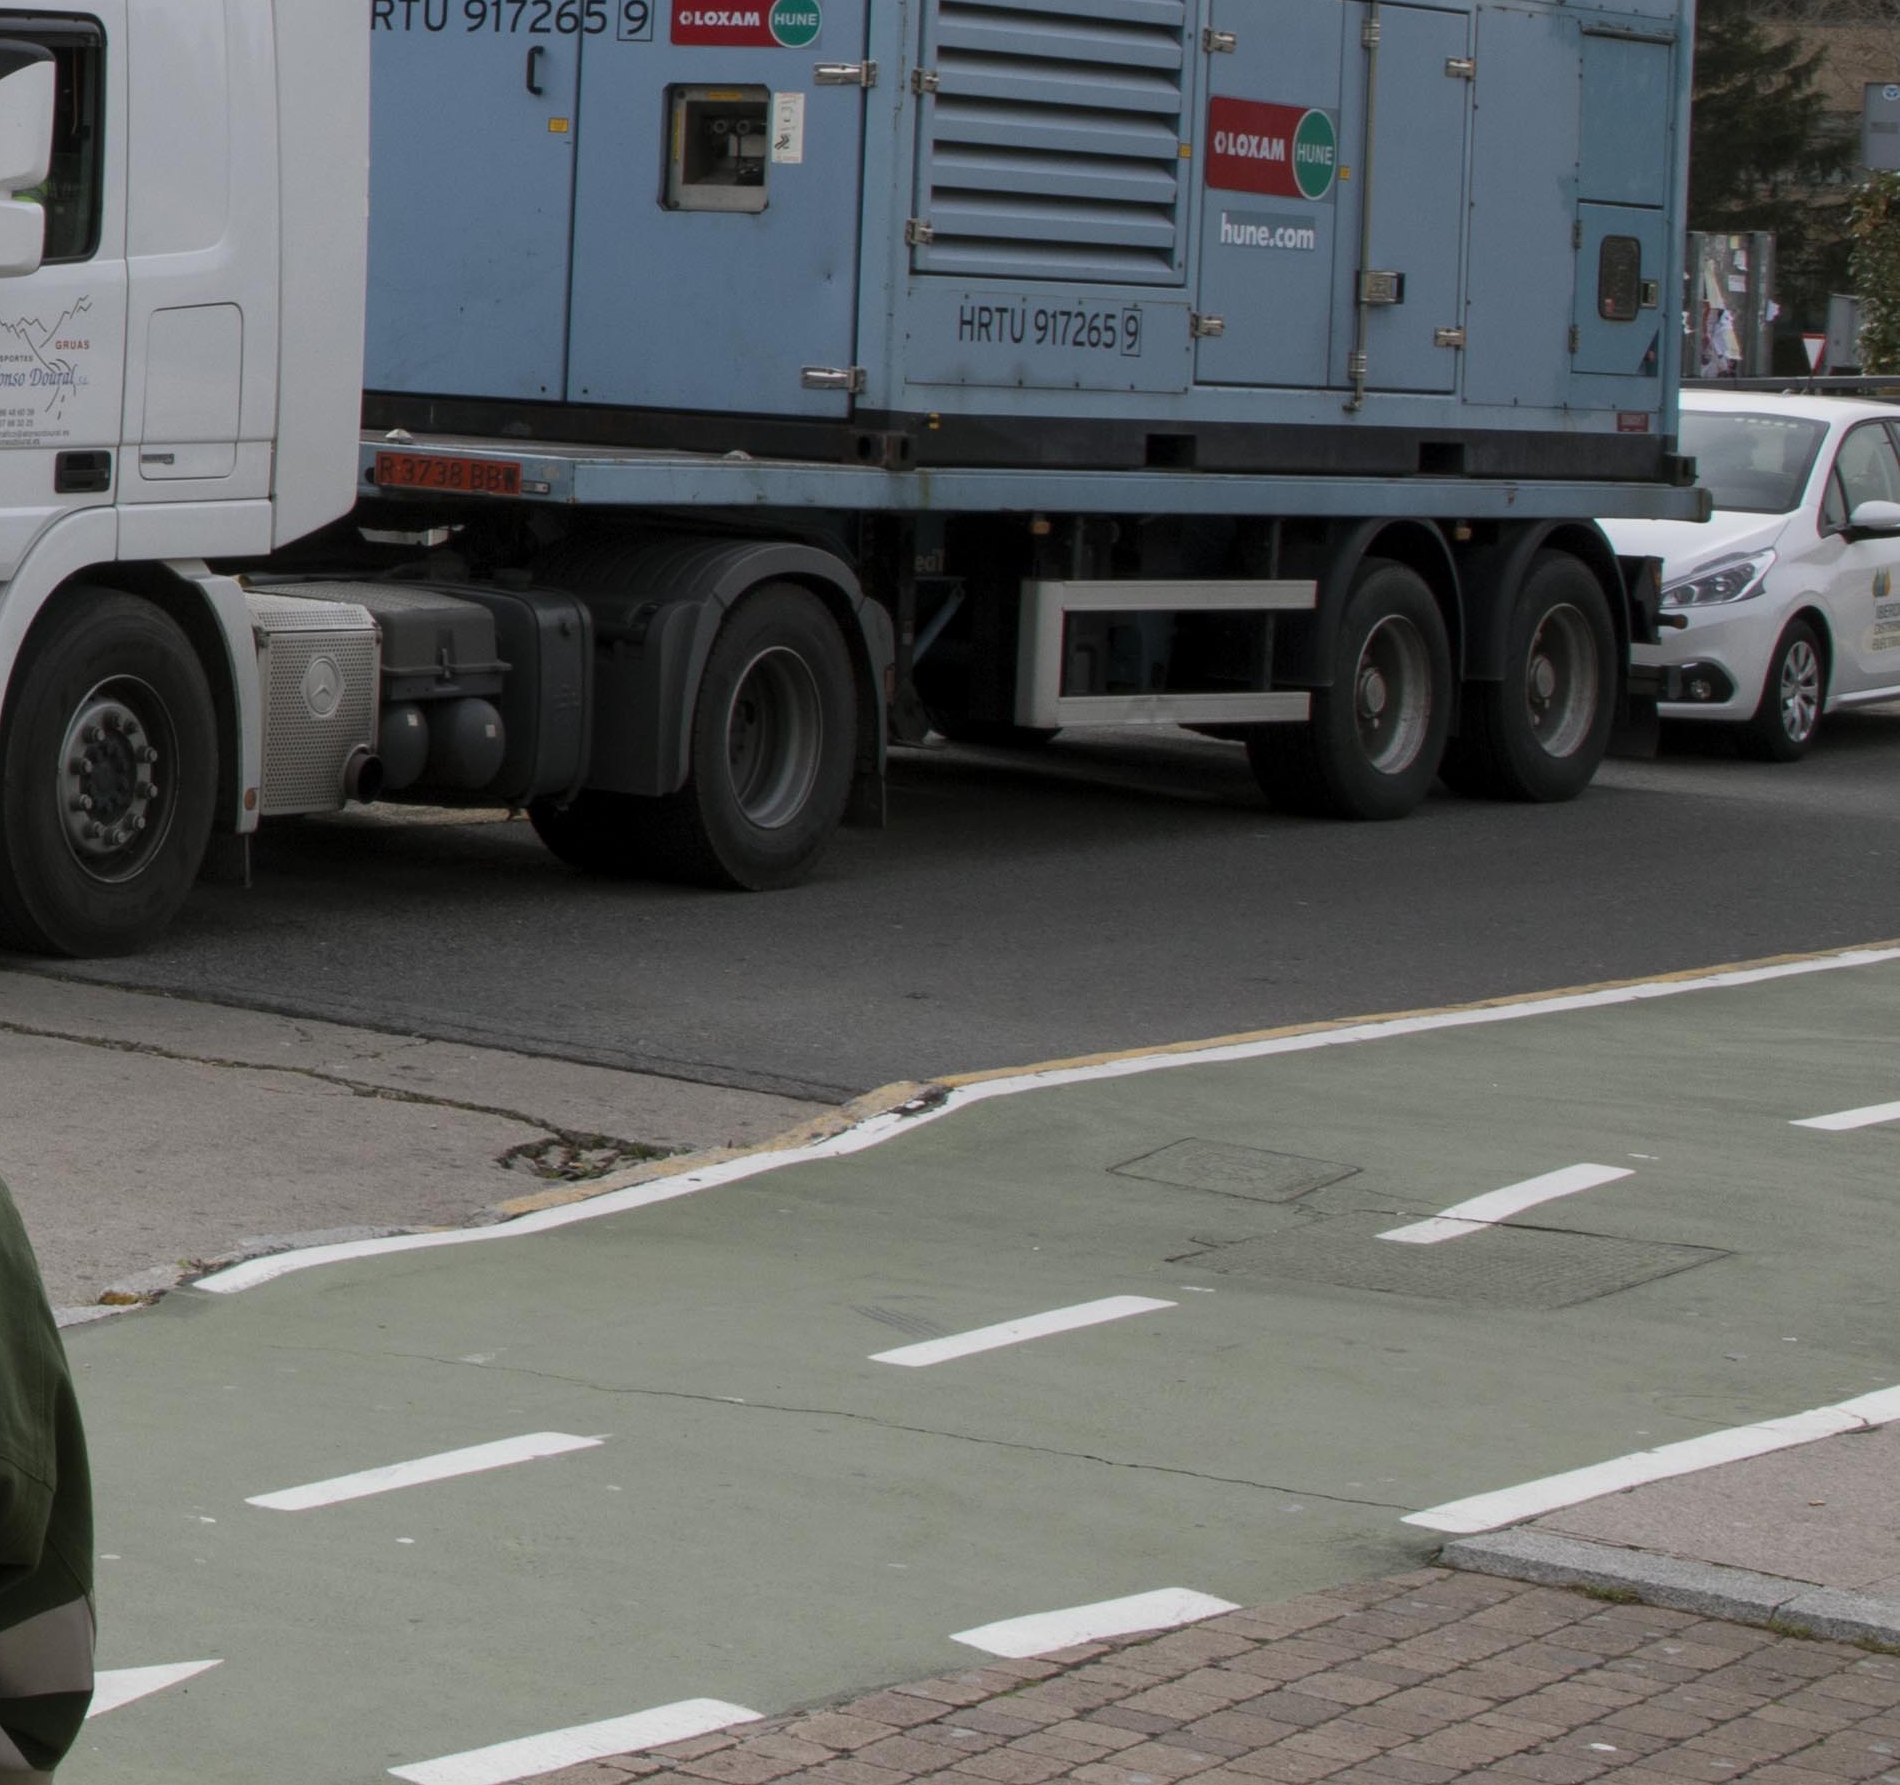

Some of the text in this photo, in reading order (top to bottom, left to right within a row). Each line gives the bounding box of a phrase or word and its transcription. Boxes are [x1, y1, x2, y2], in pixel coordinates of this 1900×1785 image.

[694, 10, 818, 27] LOXAM HUNE
[1227, 132, 1333, 166] LOXAM HUNE
[1220, 212, 1315, 250] hune.com
[958, 306, 1139, 350] HRTU 917265 9
[55, 340, 90, 350] GRUAS
[380, 456, 393, 481] R
[402, 458, 464, 487] 3738
